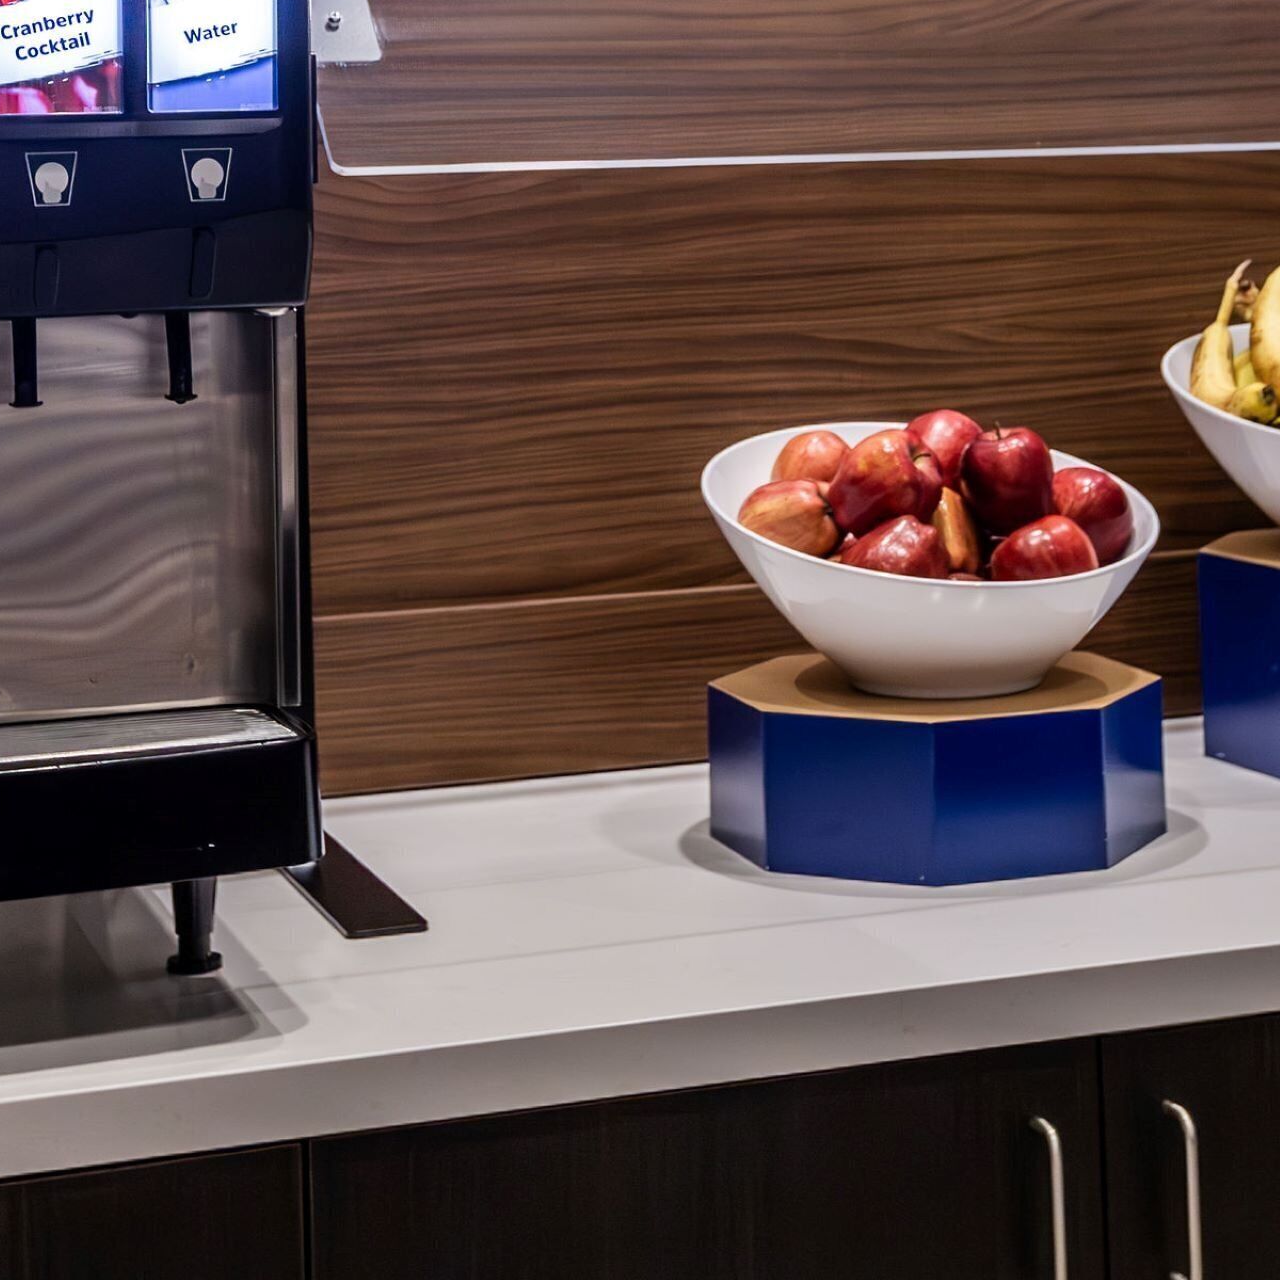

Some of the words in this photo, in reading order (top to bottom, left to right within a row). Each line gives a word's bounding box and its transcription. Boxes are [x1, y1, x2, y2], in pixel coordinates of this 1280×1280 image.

[0, 9, 95, 41] Cranberry
[183, 22, 239, 44] Water
[14, 31, 92, 61] Cocktail
